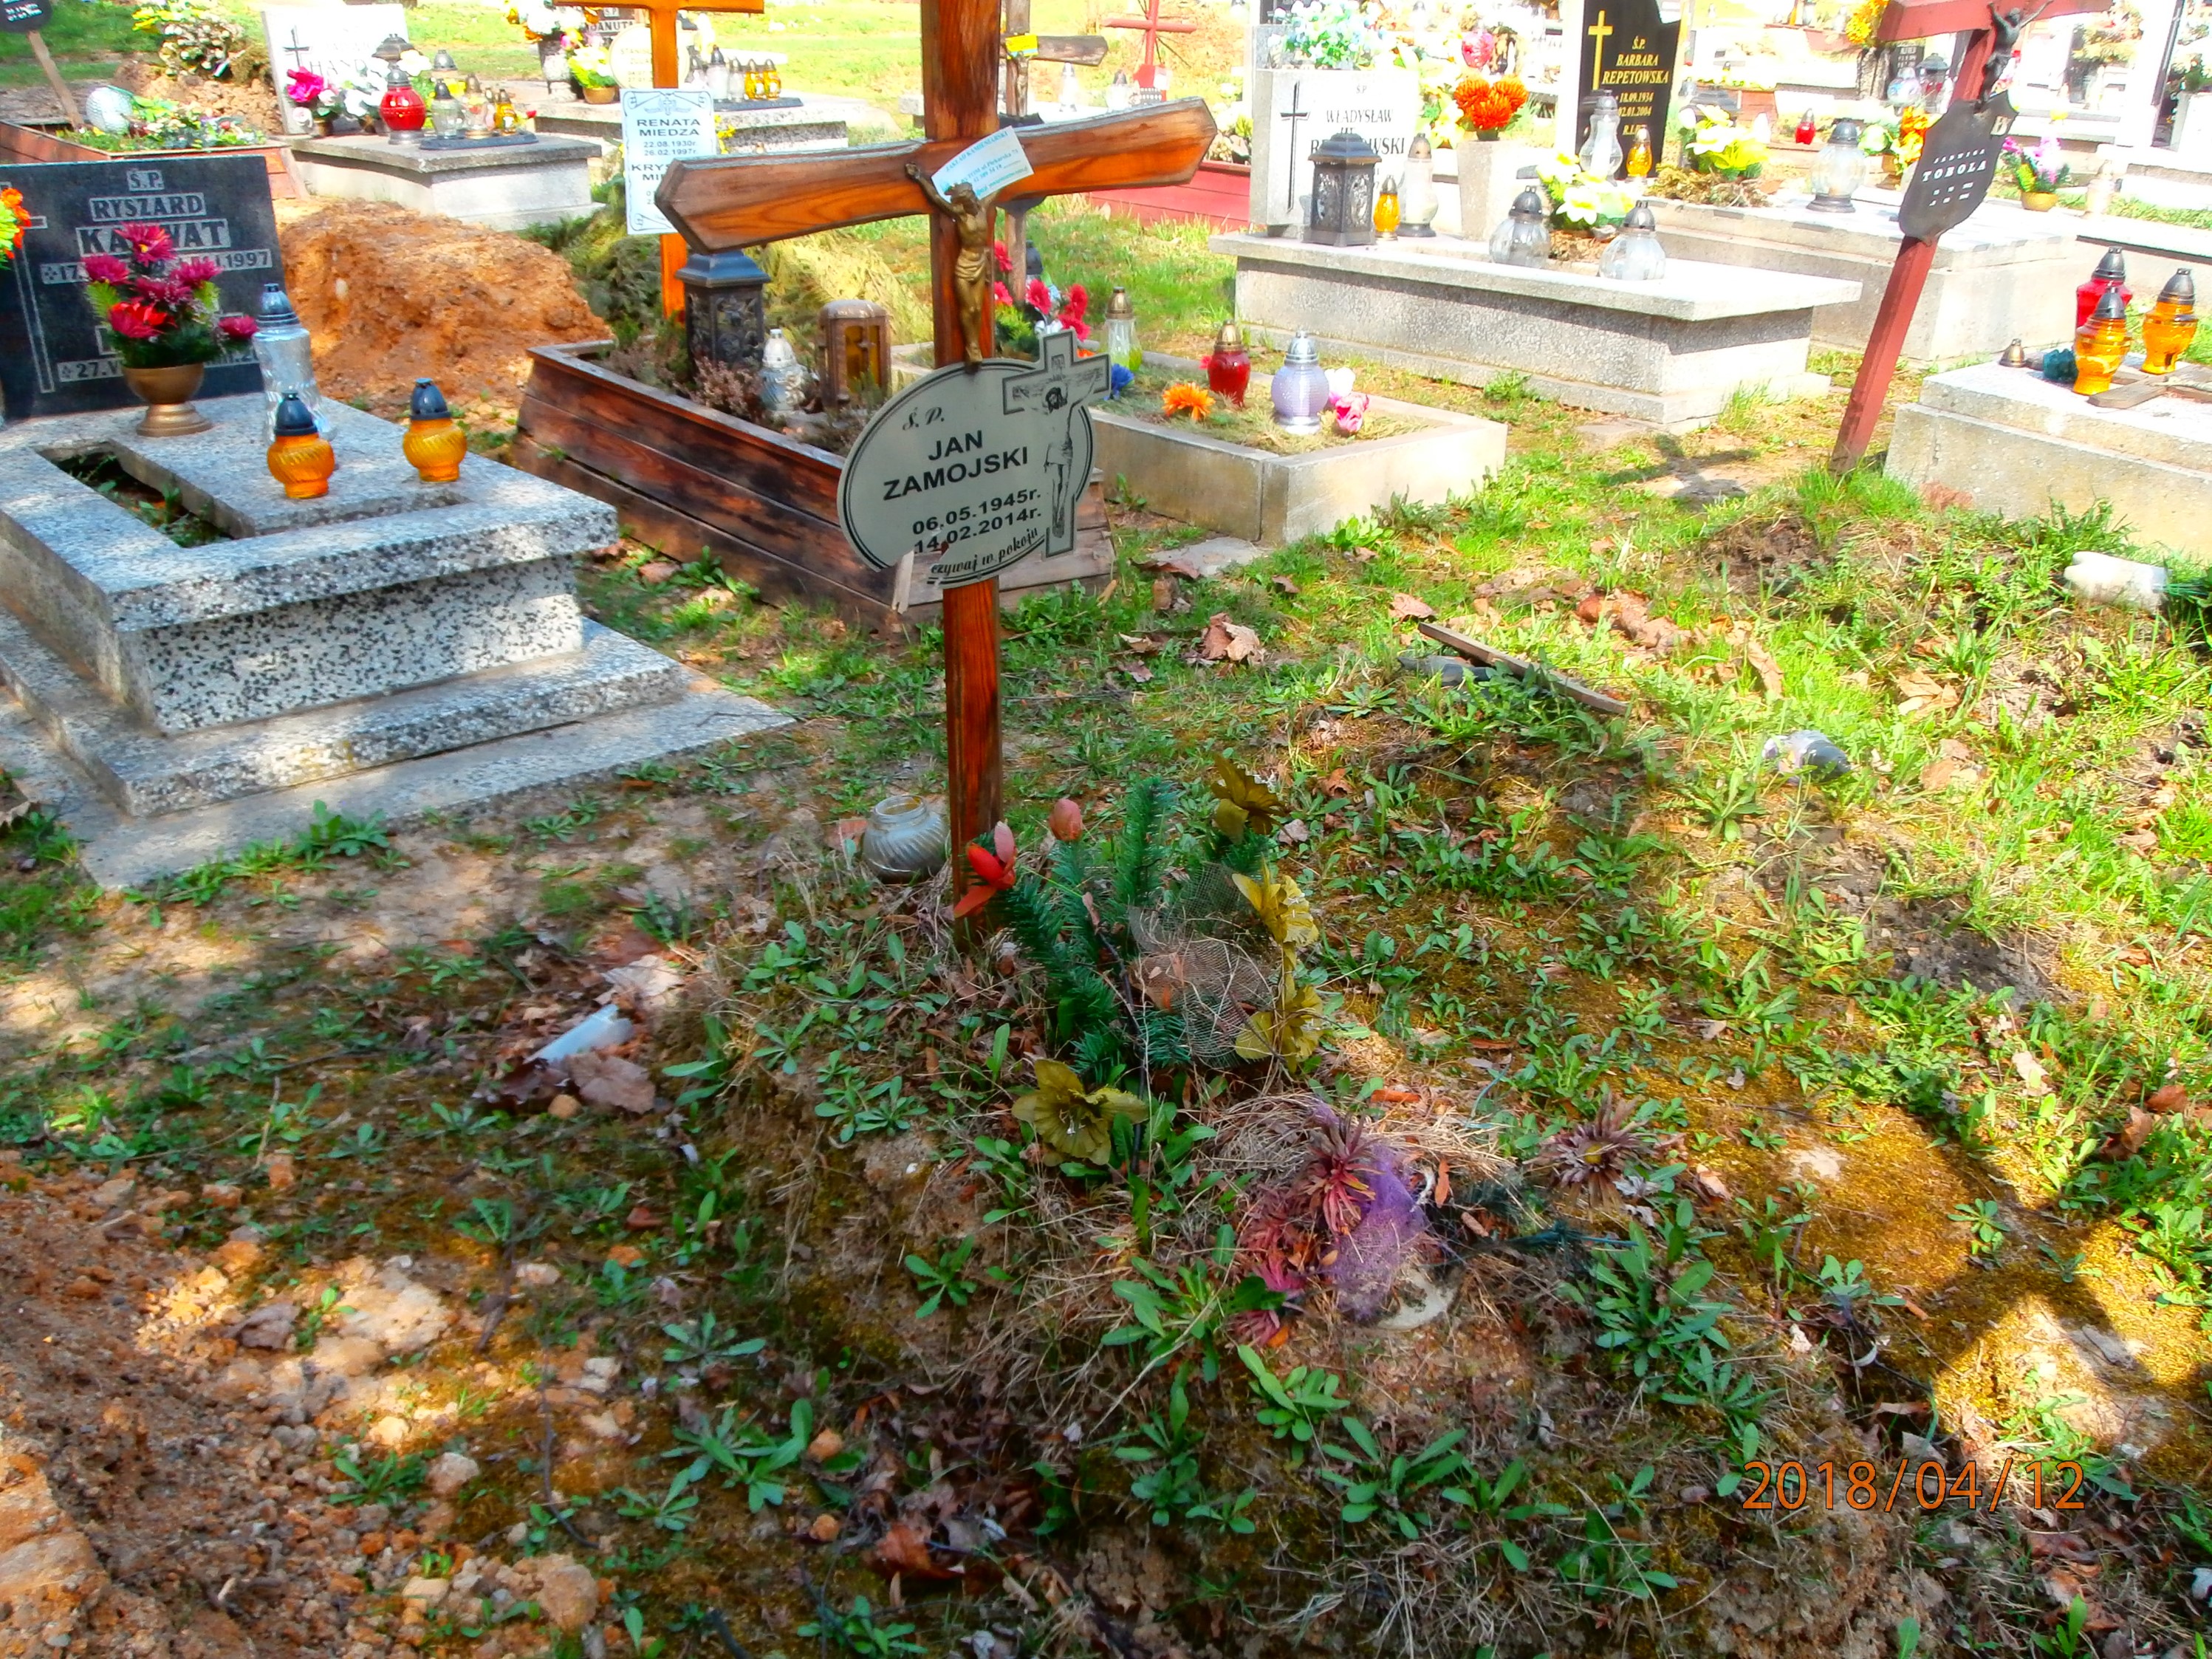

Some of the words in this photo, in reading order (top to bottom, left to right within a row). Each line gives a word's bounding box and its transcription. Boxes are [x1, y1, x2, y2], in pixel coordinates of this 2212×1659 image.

[1616, 54, 1660, 66] BARBARA
[1601, 71, 1669, 85] REPETOWSKA
[637, 118, 701, 127] RENATA
[1326, 109, 1393, 123] WŁADYSŁAW
[639, 129, 699, 137] MIEDZA
[644, 140, 697, 148] 22.08.1930r.
[1922, 160, 1987, 182] TOBOLA
[92, 195, 204, 219] RYSZARD
[925, 407, 945, 426] P.
[928, 430, 984, 461] JAN
[883, 446, 1028, 501] ZAMOJSKI
[912, 487, 1041, 535] 06.05.1945r.
[914, 507, 1041, 553] 1402.2014r.
[998, 527, 1038, 562] pokoju
